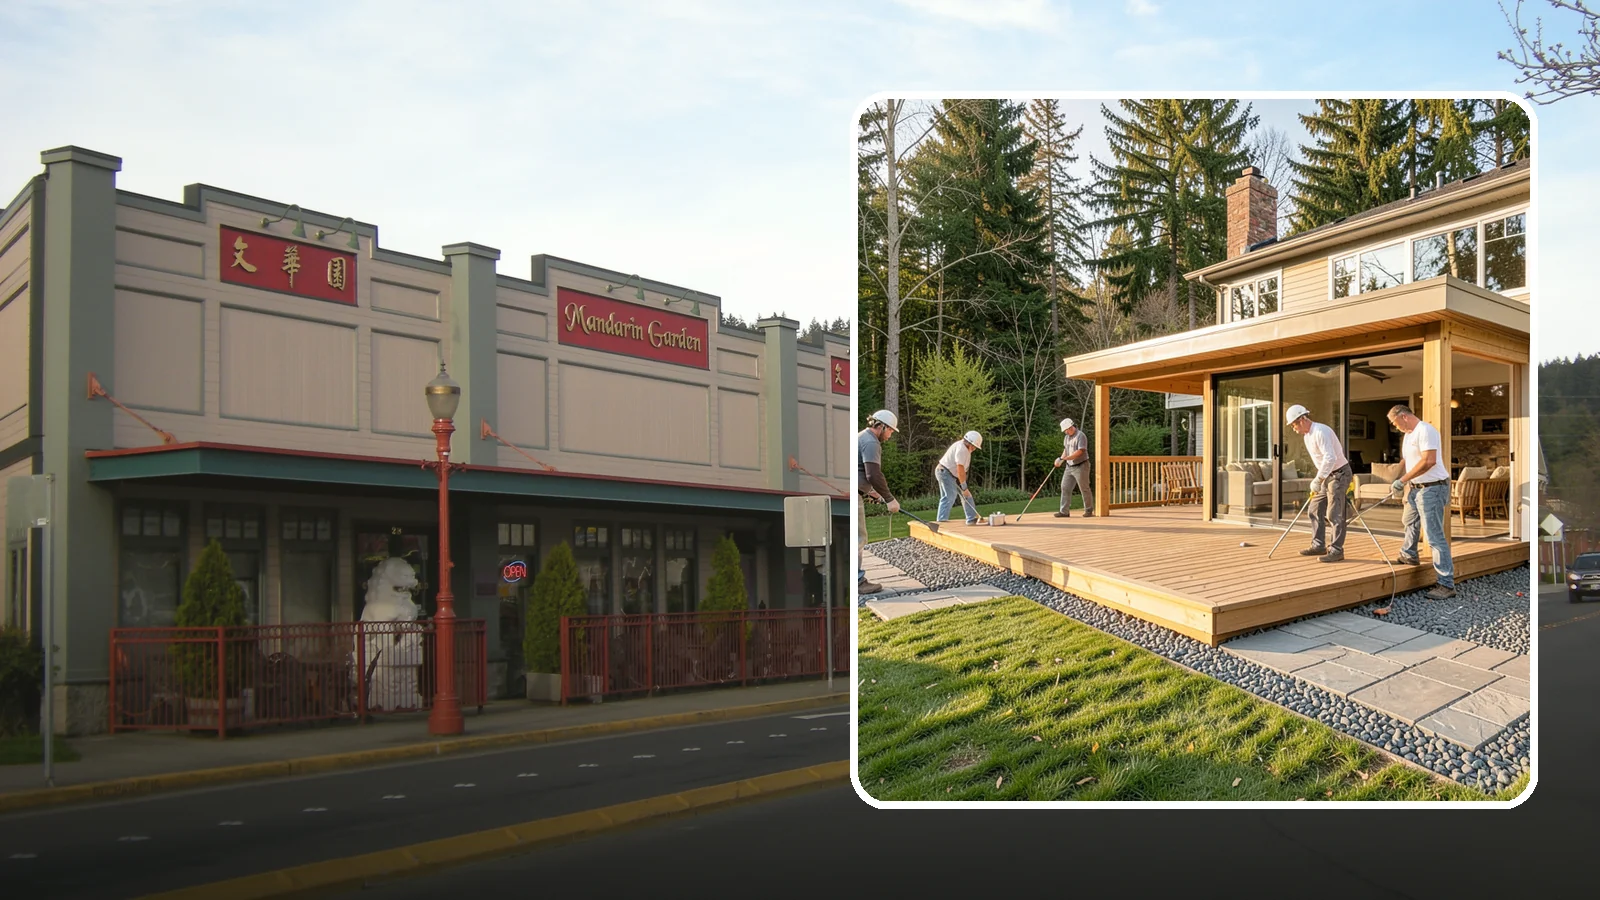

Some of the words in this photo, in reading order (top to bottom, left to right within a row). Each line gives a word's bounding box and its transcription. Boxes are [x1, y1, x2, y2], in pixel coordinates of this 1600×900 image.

[230, 235, 346, 291] 文華園
[564, 302, 644, 341] Mandarin
[648, 320, 701, 352] Garden
[503, 565, 527, 578] OPEN
